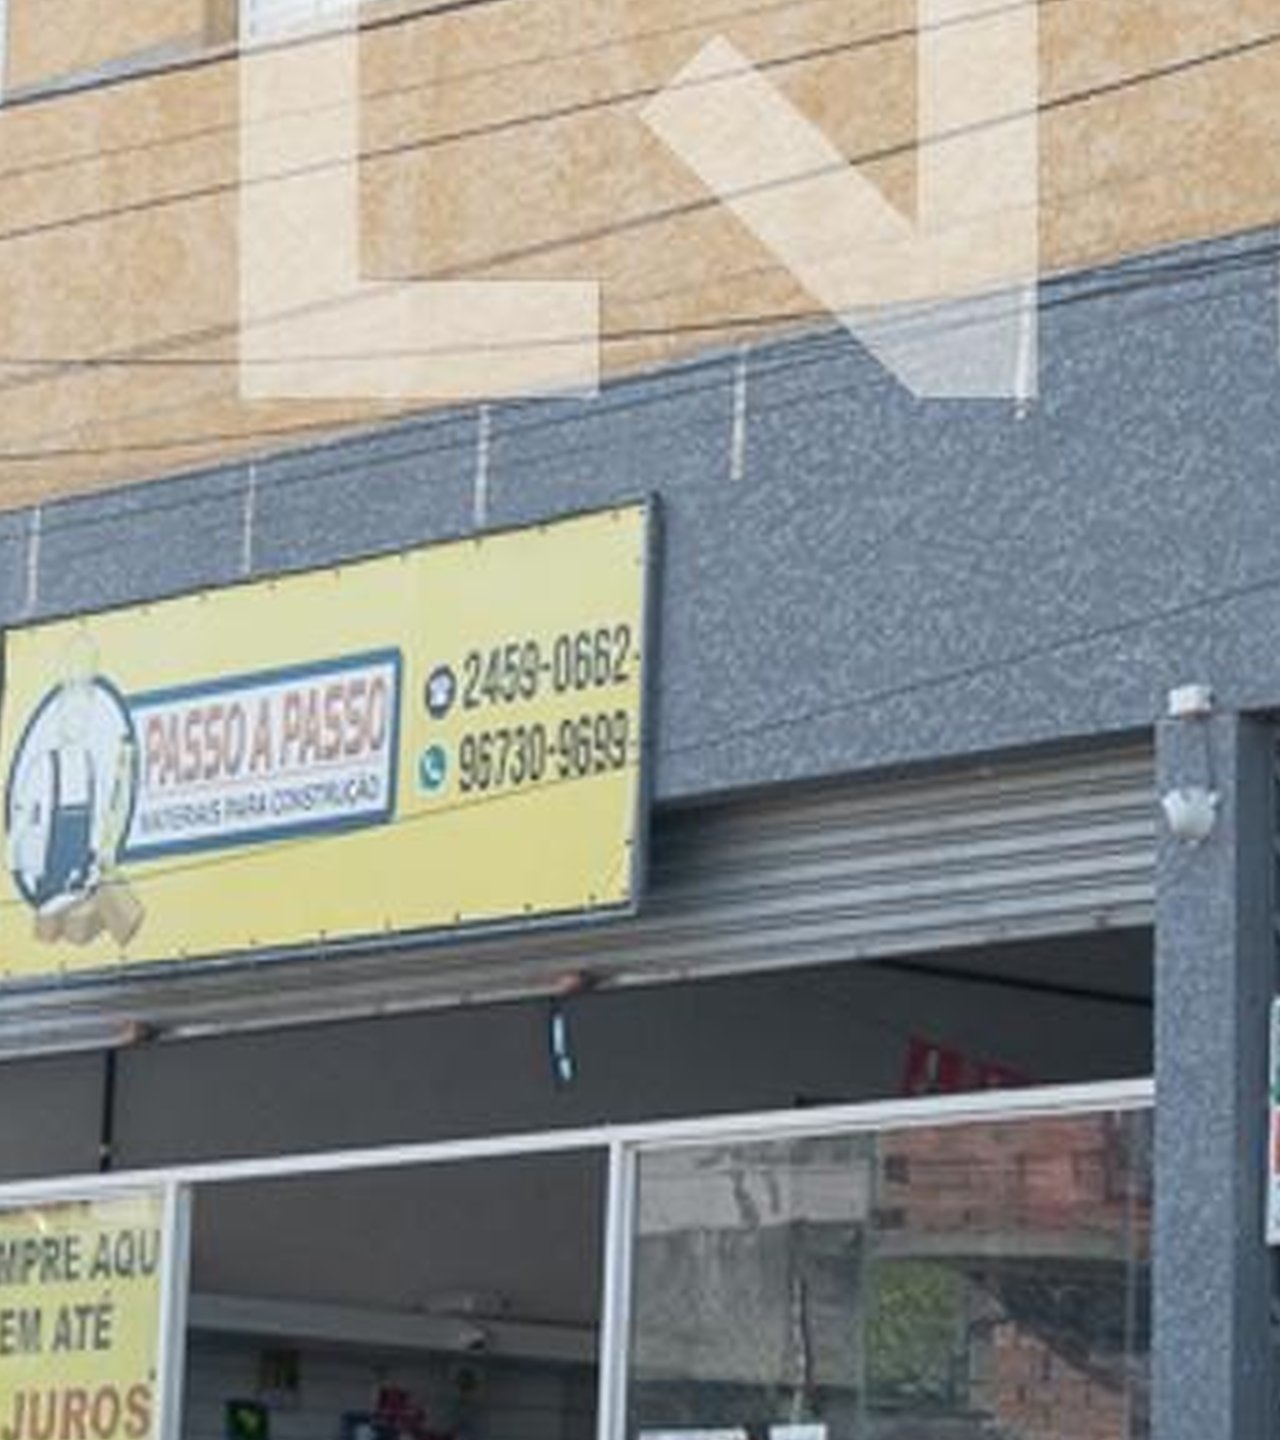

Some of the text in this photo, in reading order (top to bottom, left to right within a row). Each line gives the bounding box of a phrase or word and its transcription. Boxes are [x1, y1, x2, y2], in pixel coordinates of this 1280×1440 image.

[147, 676, 387, 786] PASSO A PASSO
[222, 791, 266, 818] PARA
[91, 1228, 161, 1280] AQU
[52, 1289, 114, 1351] ATÉ
